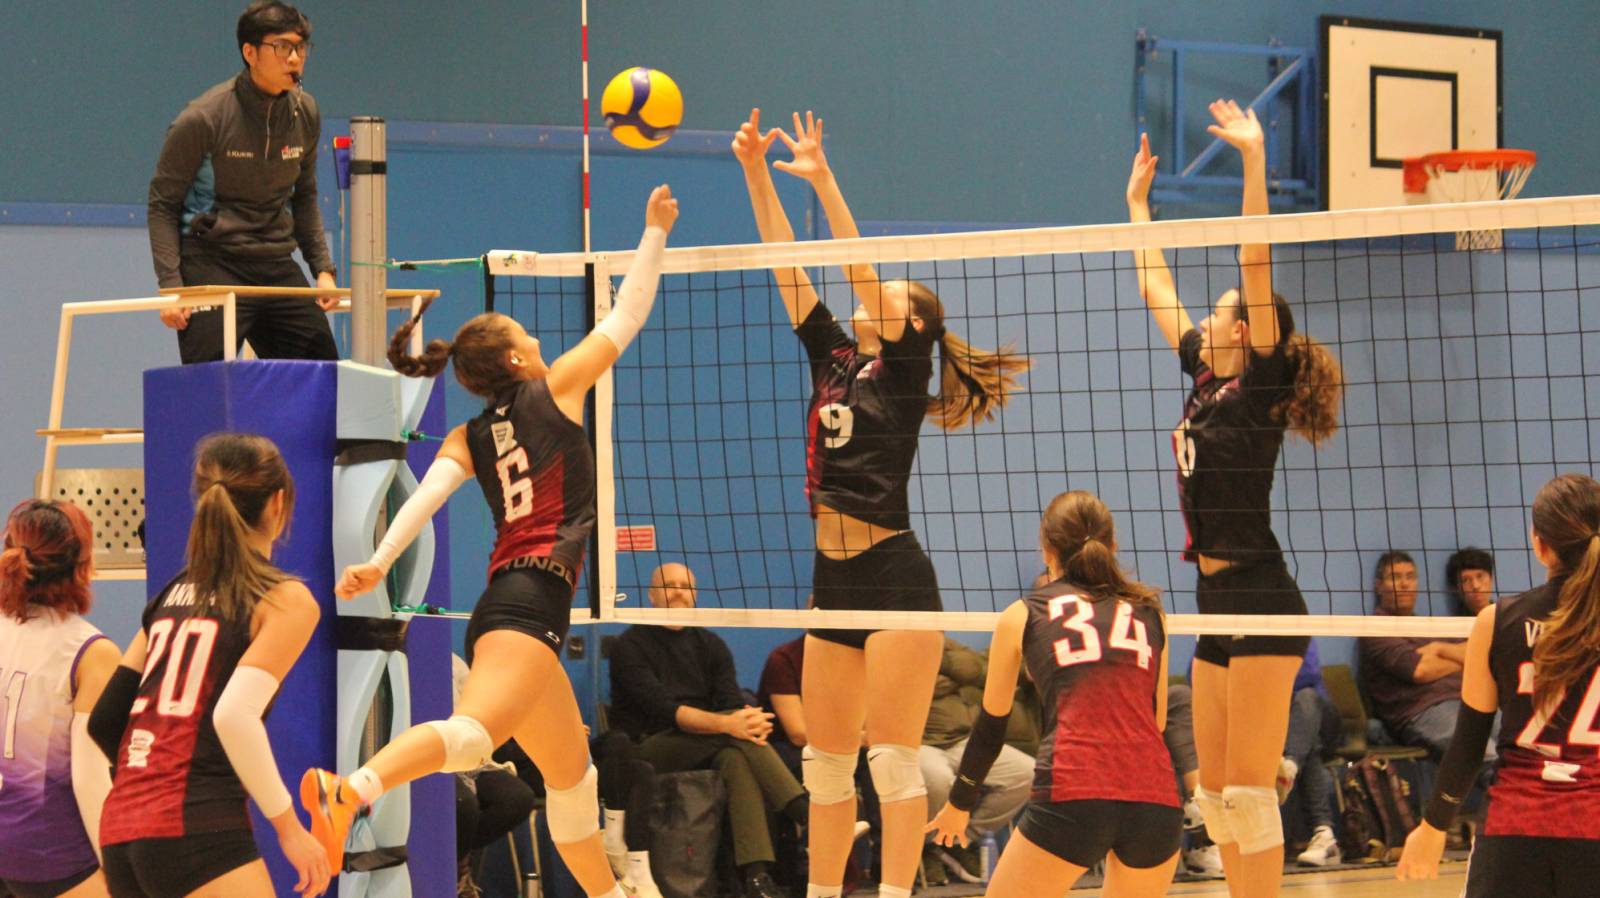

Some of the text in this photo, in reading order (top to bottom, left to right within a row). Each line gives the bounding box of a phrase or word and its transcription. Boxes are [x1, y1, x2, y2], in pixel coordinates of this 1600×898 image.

[818, 402, 854, 449] 9
[496, 446, 535, 523] 6
[129, 617, 220, 718] 20
[1047, 593, 1153, 671] 34
[0, 667, 28, 761] 1
